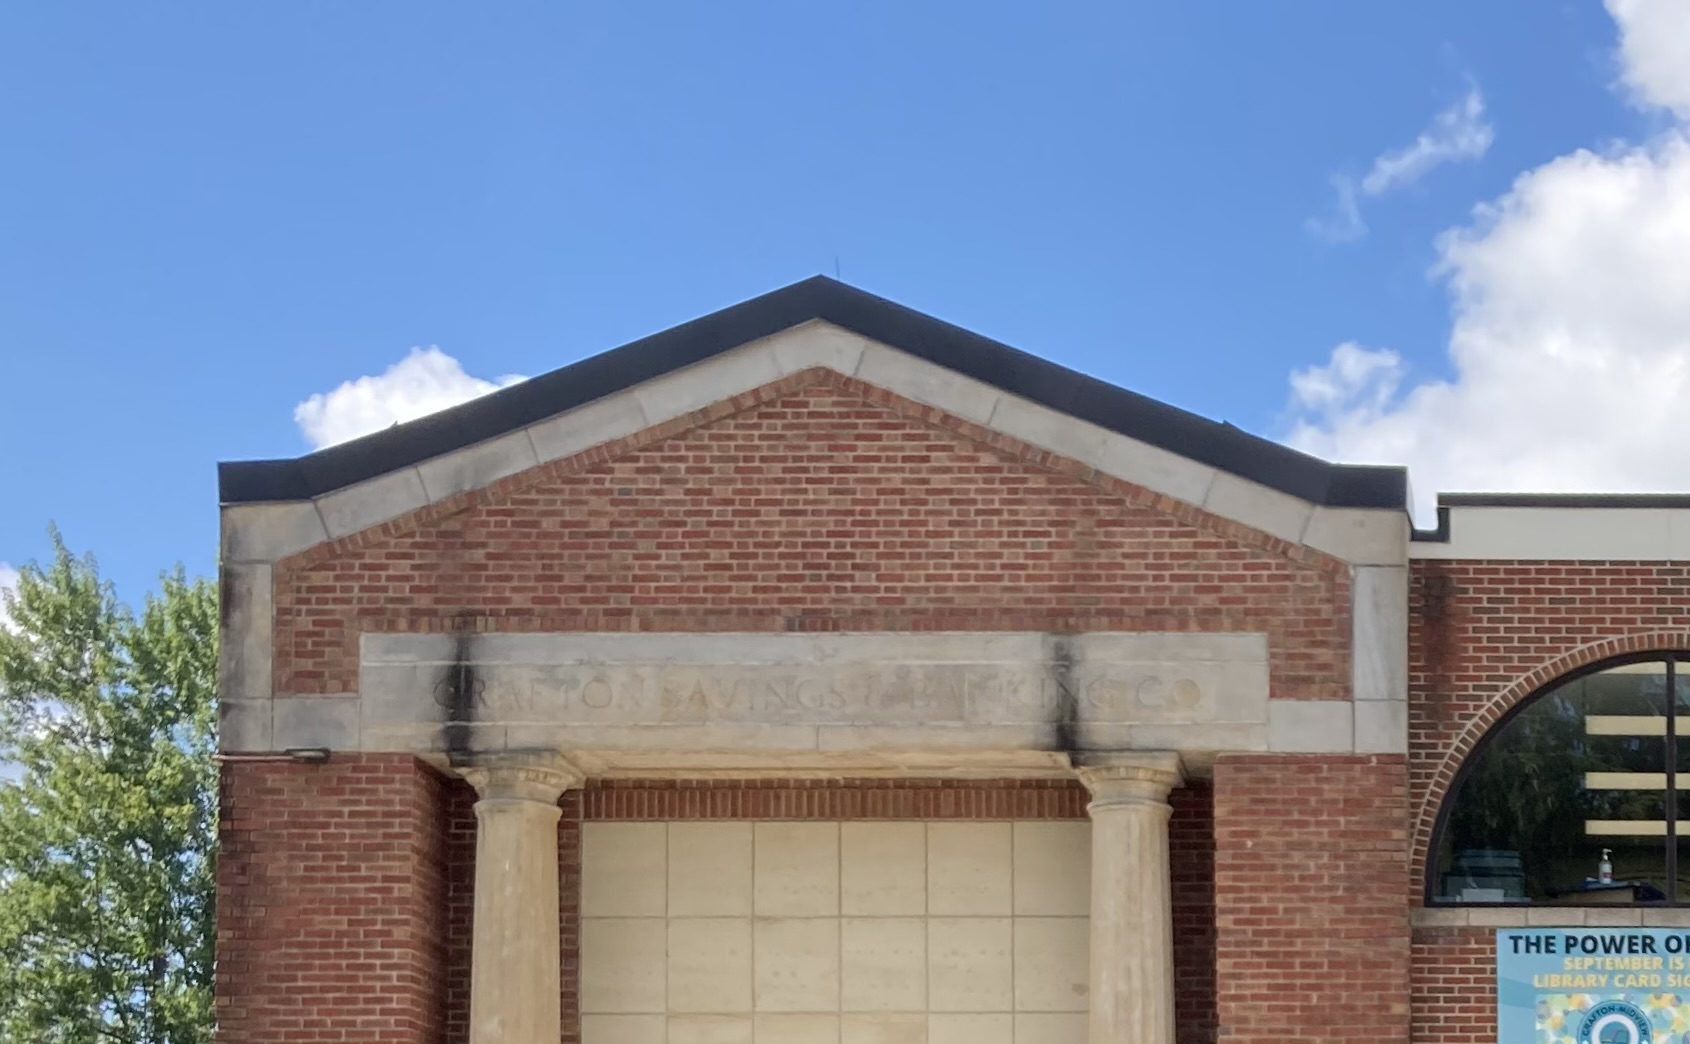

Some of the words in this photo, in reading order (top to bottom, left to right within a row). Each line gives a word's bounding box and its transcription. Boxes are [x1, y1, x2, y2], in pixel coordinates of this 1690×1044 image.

[1509, 934, 1556, 955] THE
[1565, 934, 1658, 955] POWER
[1563, 956, 1663, 971] SEPTEMBER
[1668, 956, 1684, 971] IS
[1533, 974, 1609, 988] LIBRARY
[1614, 974, 1662, 988] CARD
